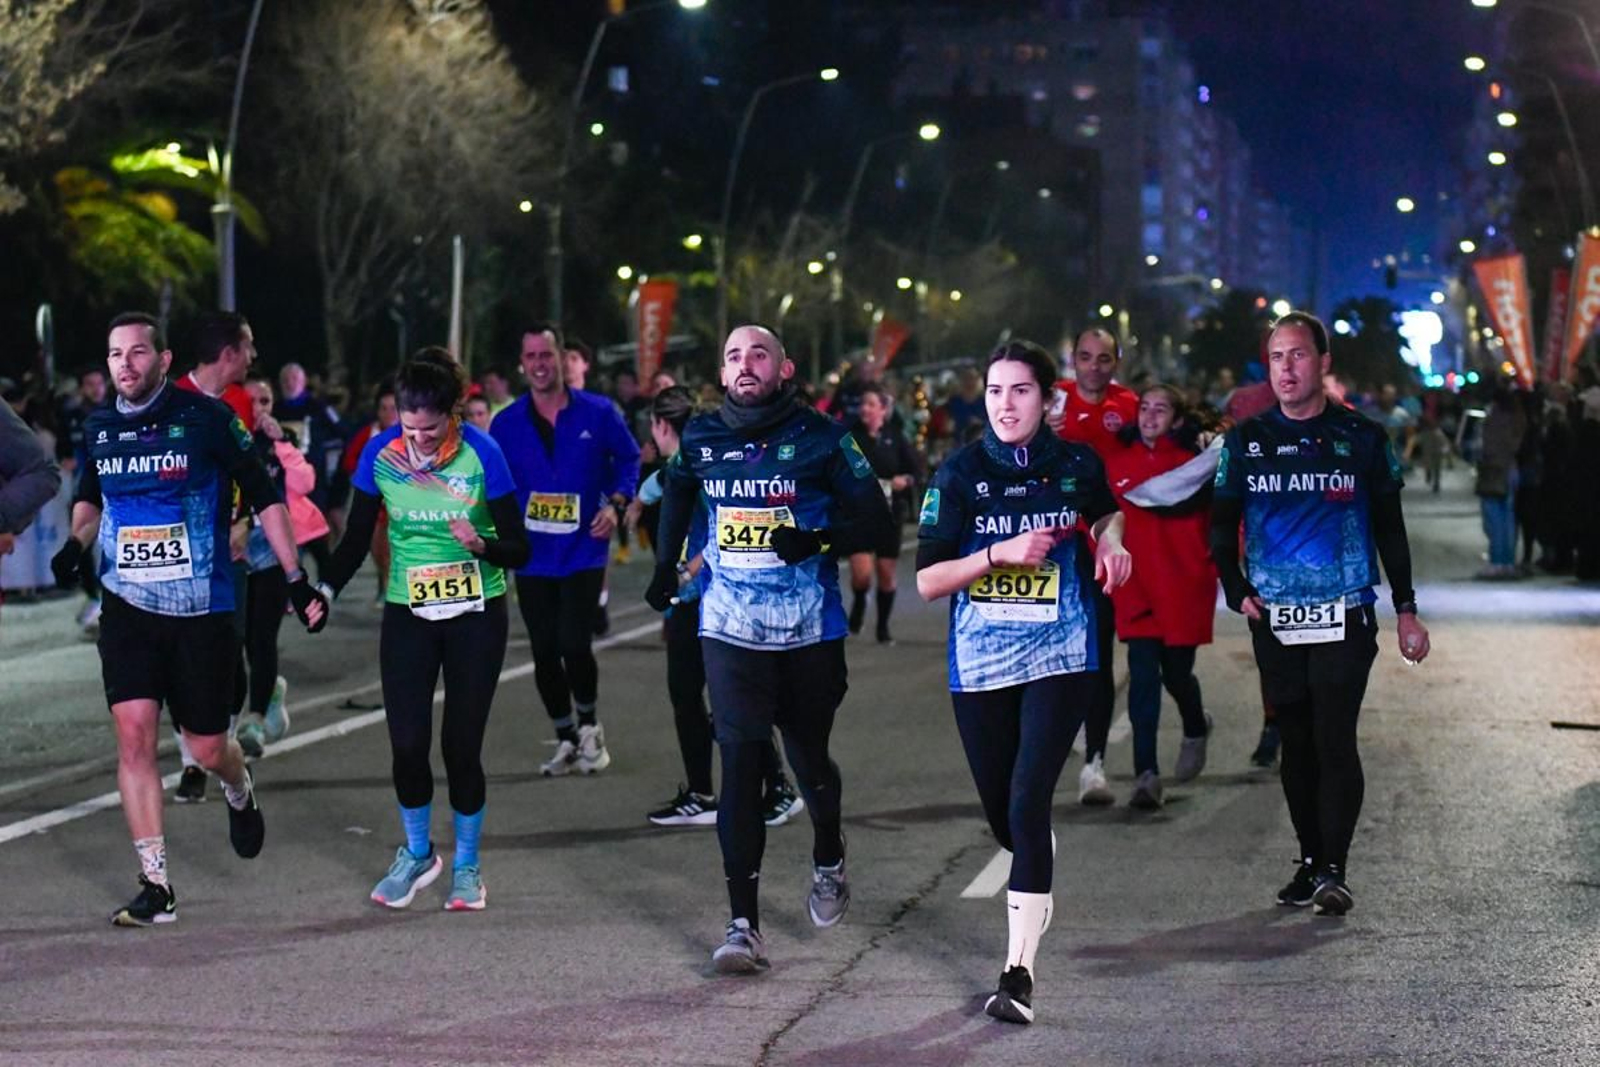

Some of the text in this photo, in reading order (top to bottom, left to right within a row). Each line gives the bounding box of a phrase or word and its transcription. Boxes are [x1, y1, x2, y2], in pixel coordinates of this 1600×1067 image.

[96, 450, 188, 475] SAN ANTÓN
[731, 474, 796, 498] ANTÓN
[1247, 469, 1355, 492] SAN ANTÓN
[408, 510, 470, 522] SAKATA
[529, 502, 574, 520] 3873
[723, 524, 775, 546] 347
[975, 515, 1012, 534] SAN
[123, 540, 184, 562] 5543
[414, 576, 473, 601] 3151
[977, 574, 1051, 597] 3607
[1277, 604, 1335, 625] 5051
